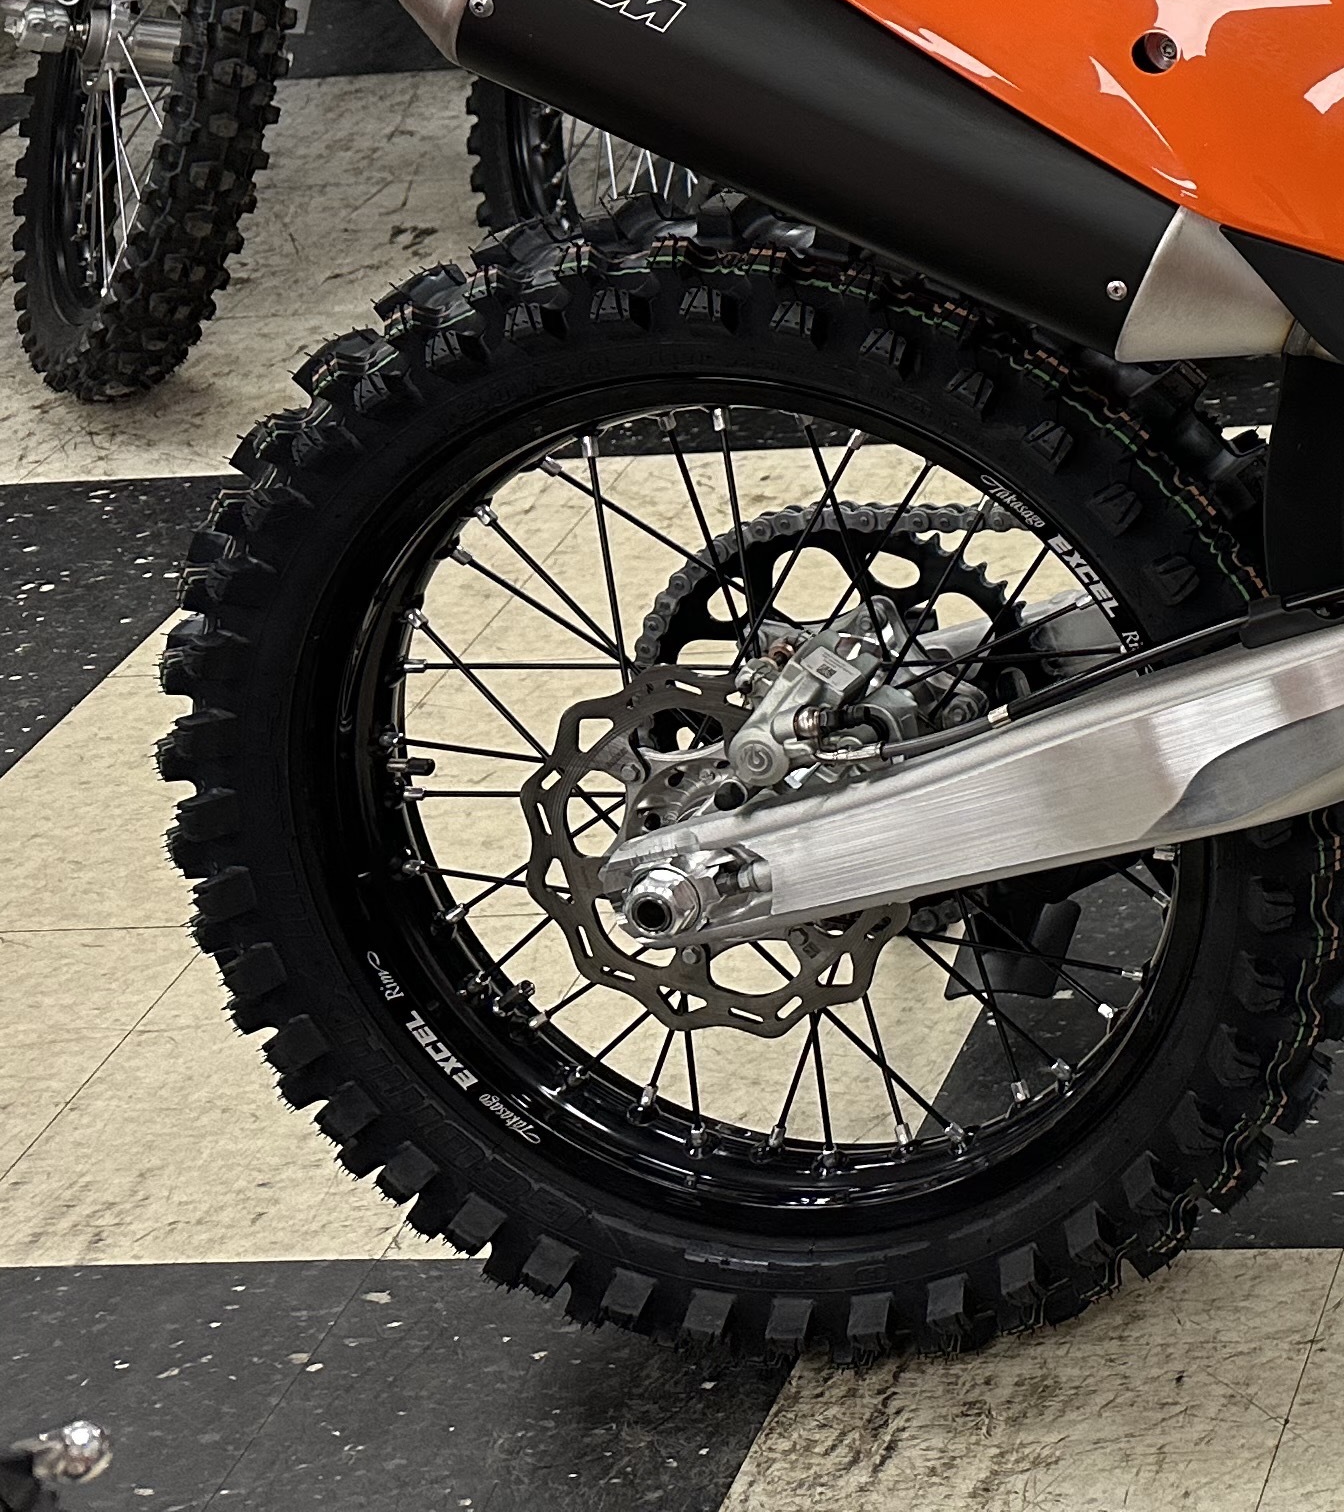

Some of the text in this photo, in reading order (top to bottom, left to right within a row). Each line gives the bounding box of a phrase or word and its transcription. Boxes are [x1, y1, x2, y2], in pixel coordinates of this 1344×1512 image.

[367, 950, 541, 1144] Rim EXCEL Takasago
